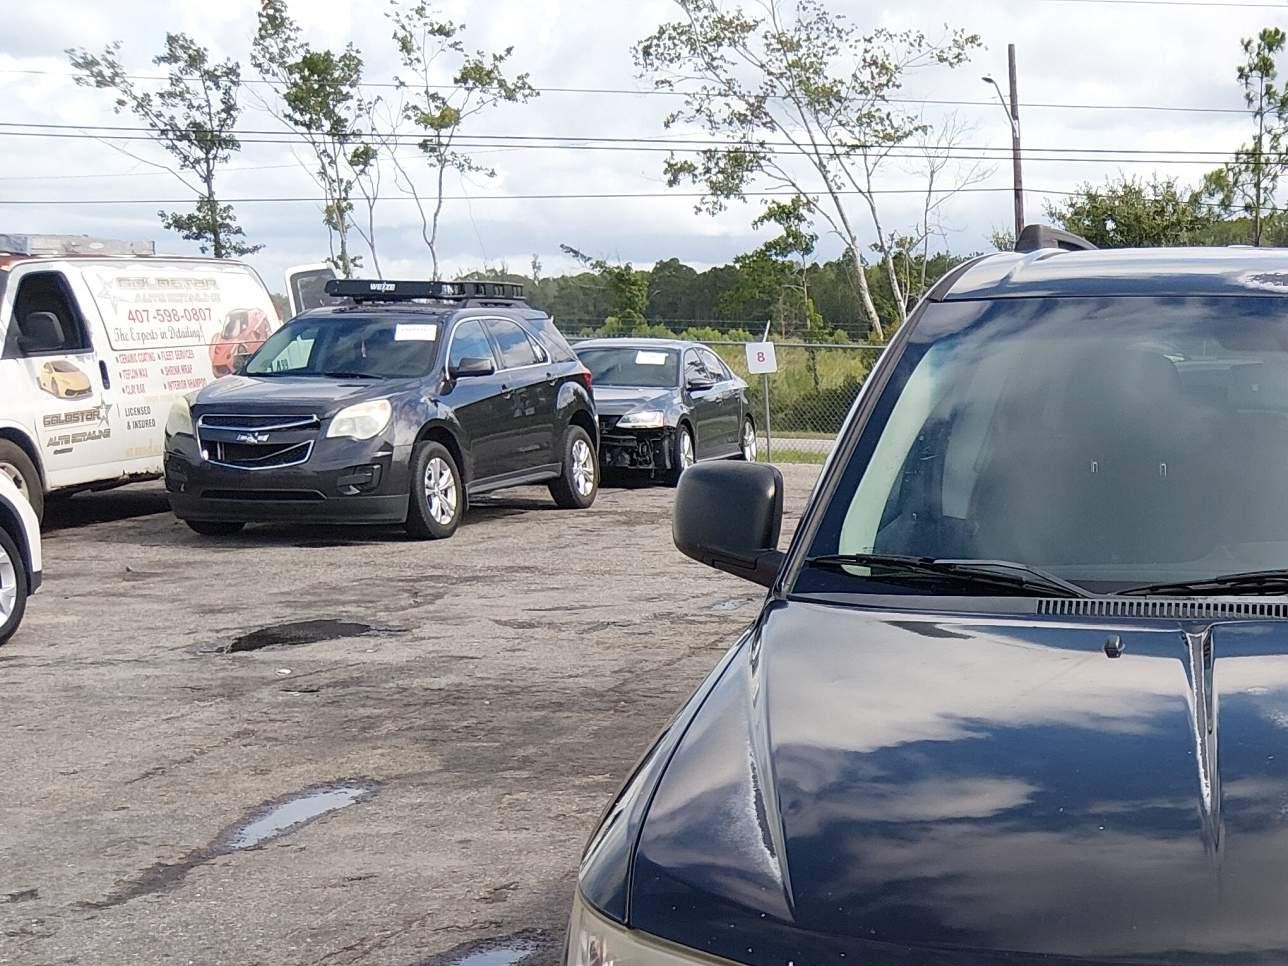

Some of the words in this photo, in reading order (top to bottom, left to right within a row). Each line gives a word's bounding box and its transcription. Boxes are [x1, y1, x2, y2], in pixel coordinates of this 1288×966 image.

[128, 308, 212, 323] 407-598-0807
[757, 352, 765, 362] B
[124, 405, 151, 417] LICENSED
[132, 419, 156, 430] INSURED
